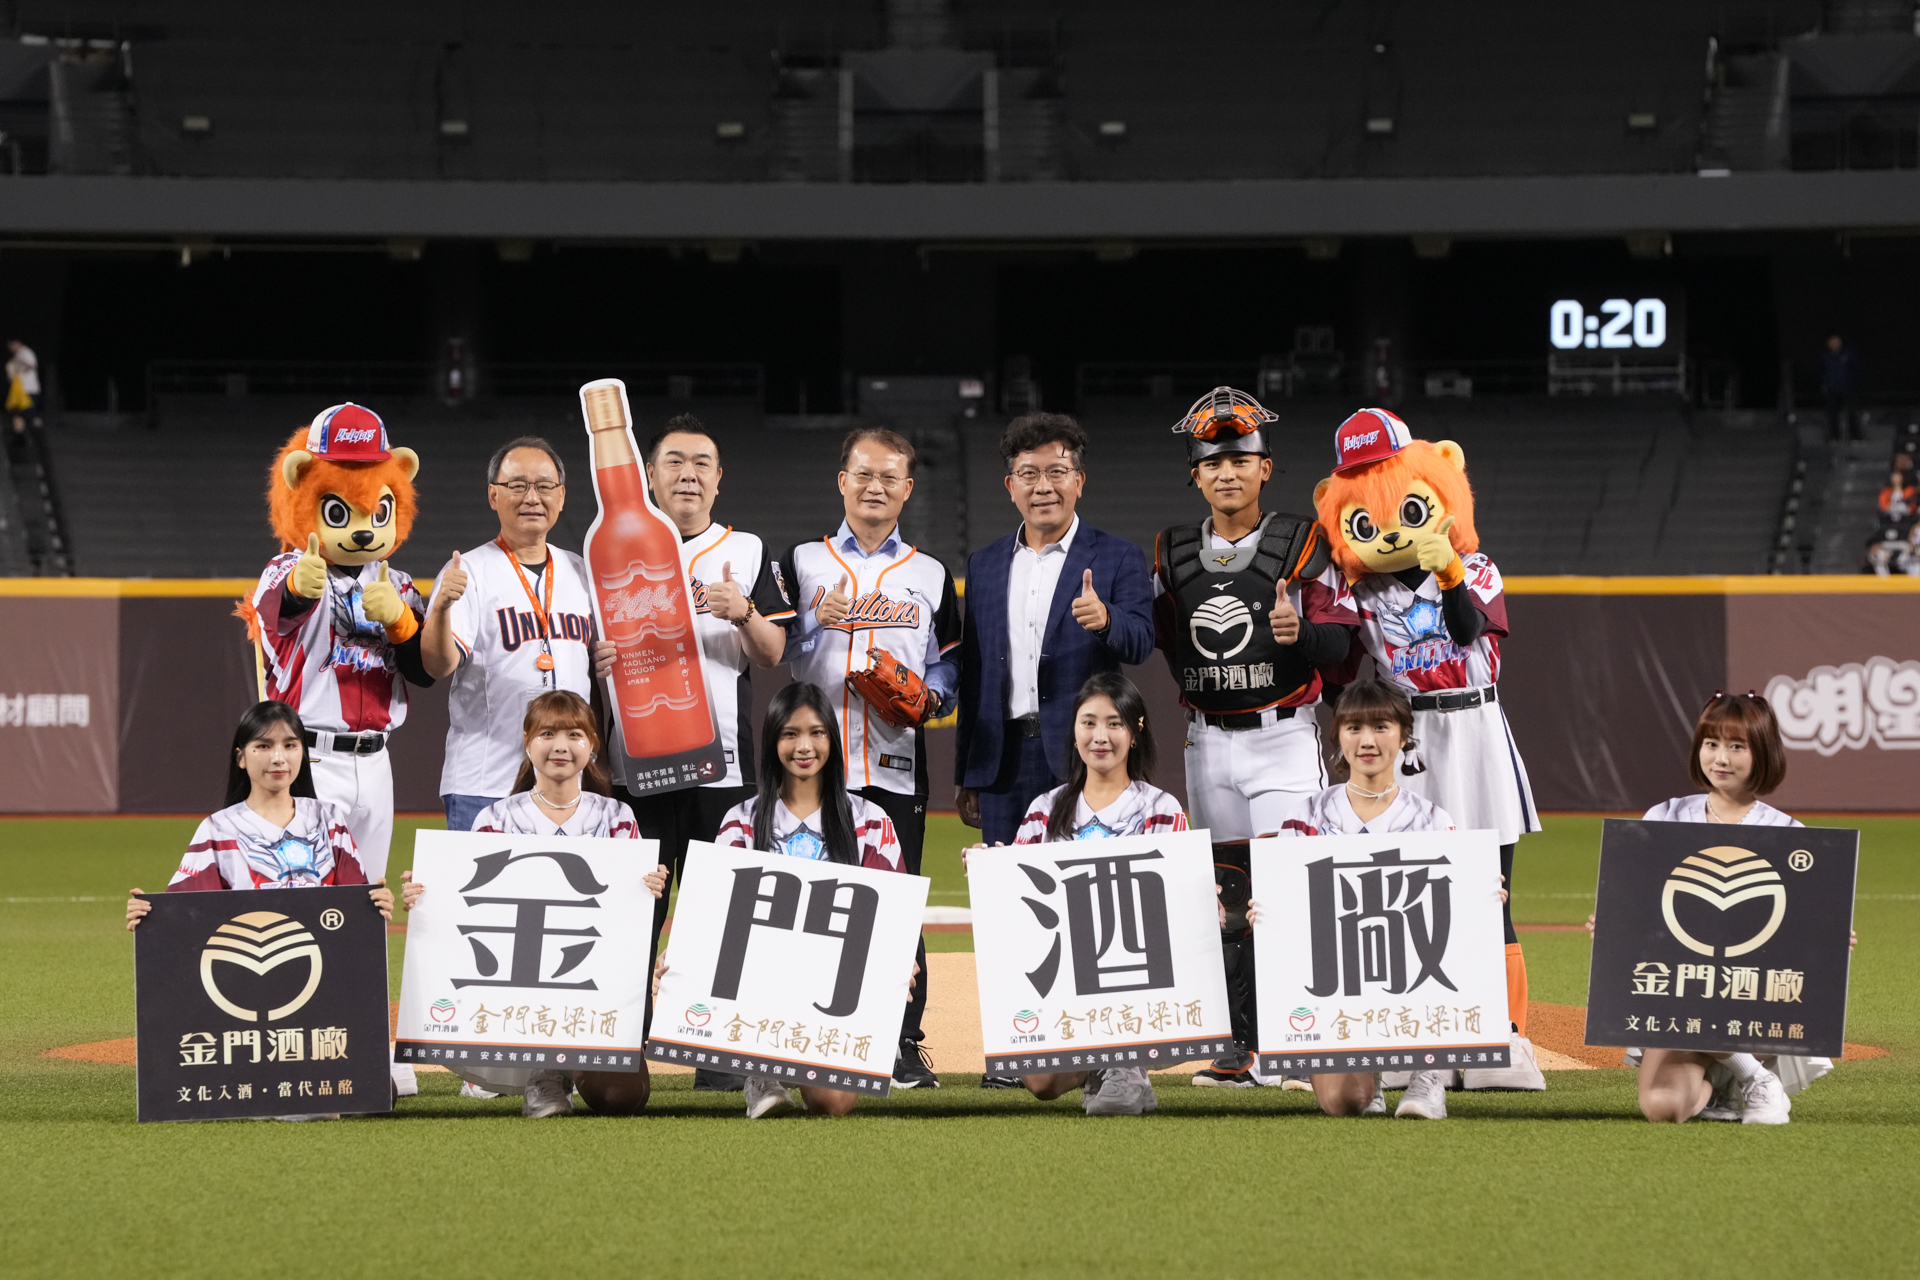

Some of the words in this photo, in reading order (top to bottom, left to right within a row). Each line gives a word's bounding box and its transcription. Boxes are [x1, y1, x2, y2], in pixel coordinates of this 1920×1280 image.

[1550, 298, 1667, 349] 0:20
[621, 649, 655, 660] KINMEN
[623, 655, 666, 668] KAOLIANG
[624, 665, 656, 676] LIQUOR
[1183, 662, 1276, 692] 金門酒廠
[637, 766, 675, 781] 酒後不開車
[682, 763, 697, 773] 禁止
[638, 776, 677, 790] 安全有保障
[683, 772, 699, 782] 酒駕
[450, 849, 609, 991] 金
[1017, 849, 1175, 999] 酒
[1304, 848, 1459, 997] 廠
[710, 866, 880, 1018] 門
[1630, 961, 1805, 1004] 金門酒廠
[469, 1002, 619, 1038] 金門高粱酒
[723, 1013, 873, 1062] 金門高粱酒
[1054, 999, 1203, 1041] 金門高粱酒
[1330, 1005, 1482, 1041] 金門高粱酒
[178, 1025, 349, 1067] 金門酒廠
[403, 1048, 469, 1060] 酒後不開車
[480, 1051, 546, 1062] 安全有保障
[578, 1054, 632, 1066] 禁止酒駕
[995, 1056, 1061, 1071] 酒後不開車
[1072, 1050, 1138, 1065] 安全有保障
[1171, 1042, 1225, 1057] 禁止酒駕
[1268, 1057, 1335, 1070] 酒後不開車
[1346, 1055, 1414, 1067] 安全有保障
[1447, 1052, 1503, 1064] 禁止酒駕
[654, 1047, 720, 1065] 酒後不開車
[731, 1058, 797, 1077] 安全有保障
[828, 1074, 882, 1091] 禁止酒駕
